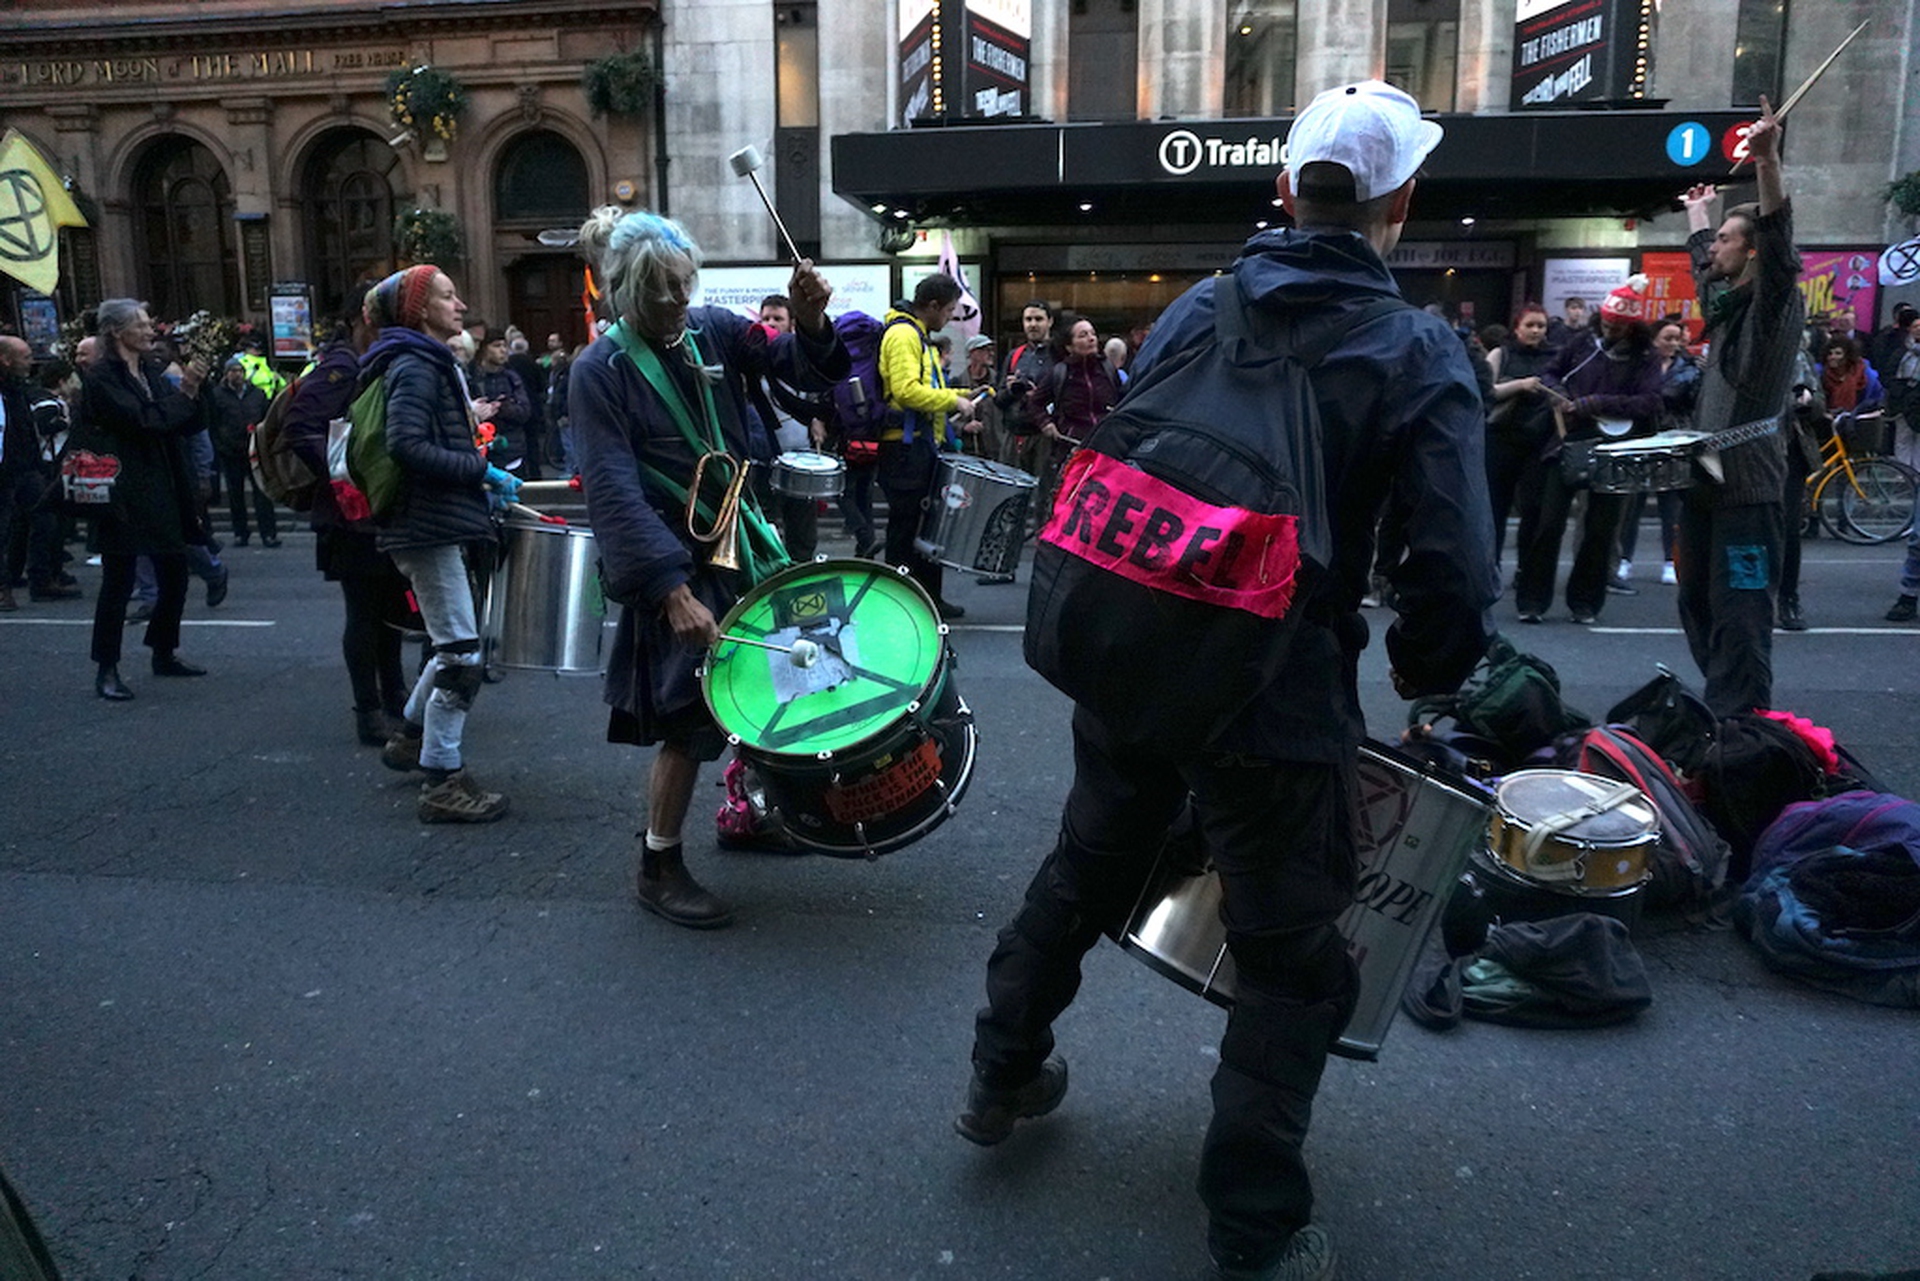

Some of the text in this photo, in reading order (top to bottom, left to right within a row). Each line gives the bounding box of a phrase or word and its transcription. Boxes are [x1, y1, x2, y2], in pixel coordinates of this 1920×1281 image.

[1521, 38, 1540, 66] THE
[1540, 15, 1602, 59] FISHERMEN
[21, 61, 83, 84] LORD
[94, 57, 161, 82] MOON
[192, 54, 240, 77] THE
[250, 51, 323, 74] MALL
[1566, 52, 1592, 97] FELL
[1681, 128, 1694, 158] 1
[704, 295, 766, 305] MASTERPI
[1649, 277, 1672, 298] THE
[1062, 480, 1246, 588] REBEL
[841, 751, 925, 798] WHERE THE
[1353, 860, 1434, 926] OPE
